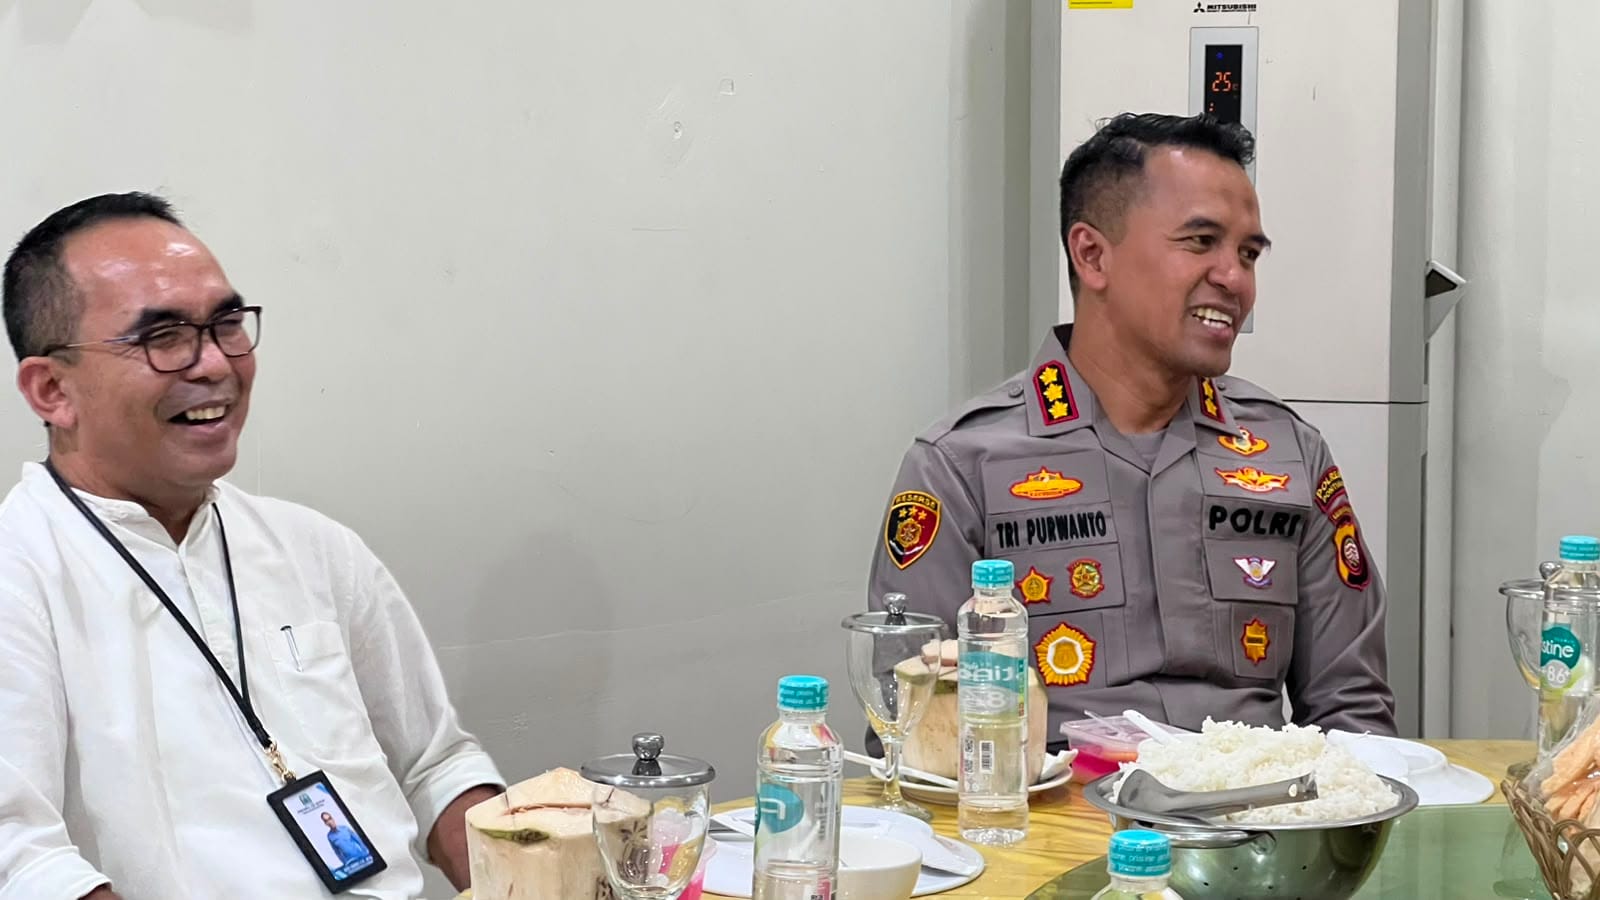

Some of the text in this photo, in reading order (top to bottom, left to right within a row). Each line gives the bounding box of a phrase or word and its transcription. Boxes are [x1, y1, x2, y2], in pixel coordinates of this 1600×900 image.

[1212, 71, 1232, 92] 25
[996, 510, 1107, 549] TRI PURWANTO
[1208, 504, 1302, 537] POLRI
